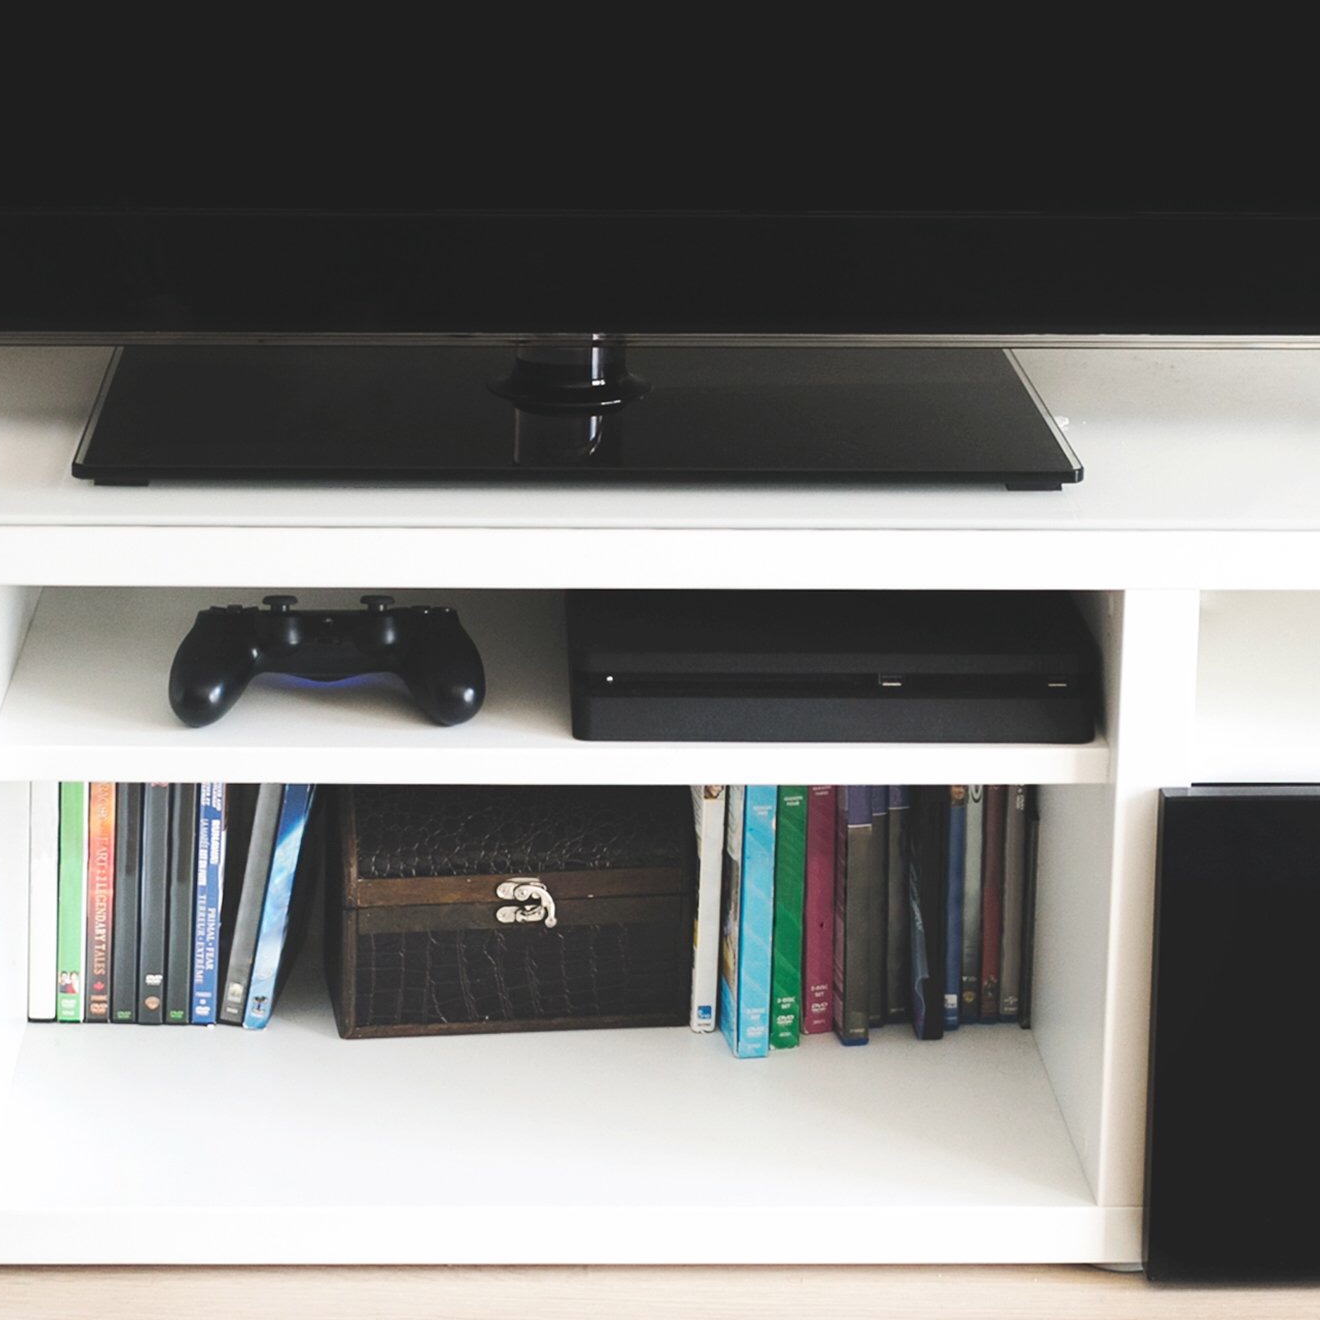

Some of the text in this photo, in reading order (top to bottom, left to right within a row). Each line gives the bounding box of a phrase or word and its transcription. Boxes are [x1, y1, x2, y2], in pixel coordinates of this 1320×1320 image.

[93, 943, 107, 976] TALES
[205, 908, 216, 970] PRIMAL FEAR
